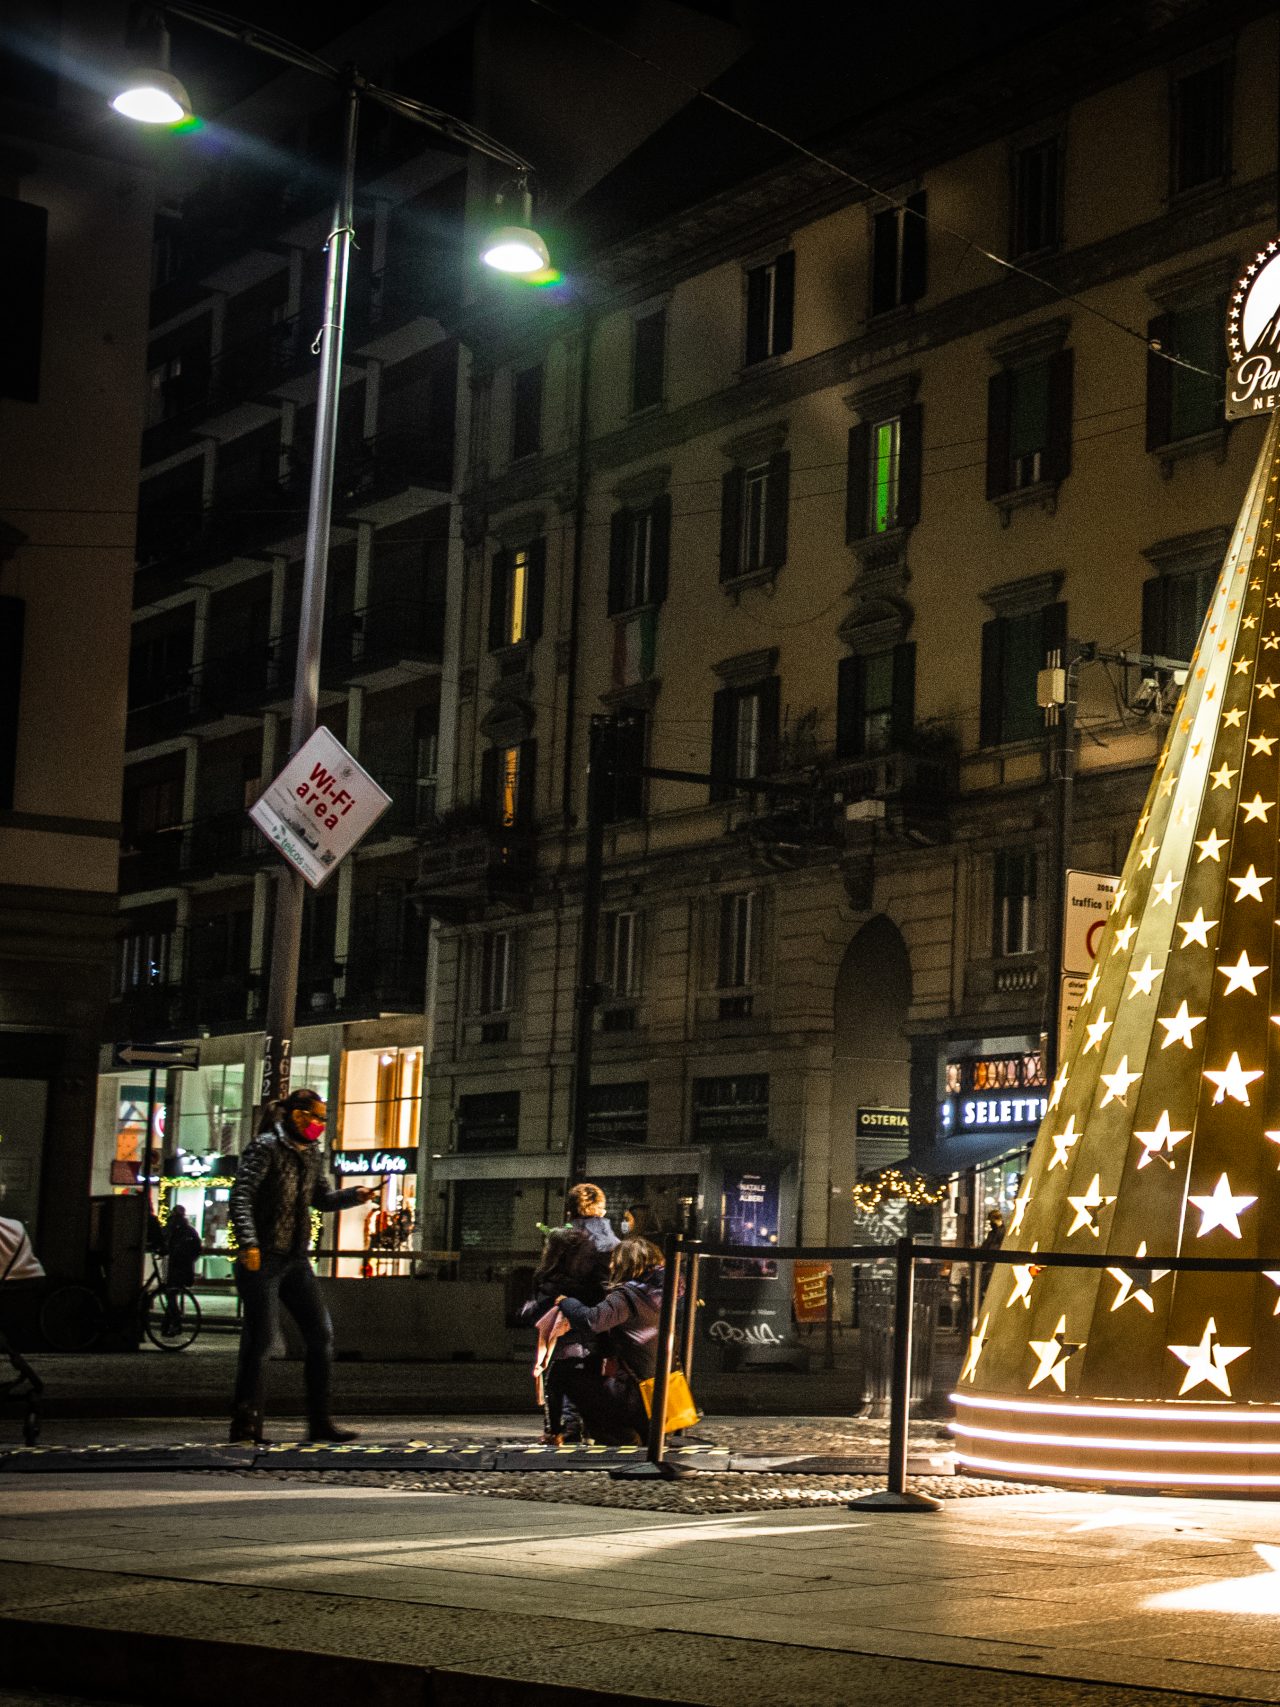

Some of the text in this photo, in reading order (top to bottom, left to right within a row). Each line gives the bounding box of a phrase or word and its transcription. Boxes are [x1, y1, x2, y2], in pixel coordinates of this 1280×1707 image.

[309, 761, 357, 816] Wi-Fi
[296, 782, 339, 830] area
[1097, 883, 1114, 893] zona
[1071, 895, 1102, 909] traffico
[860, 1114, 909, 1127] OSTERIA
